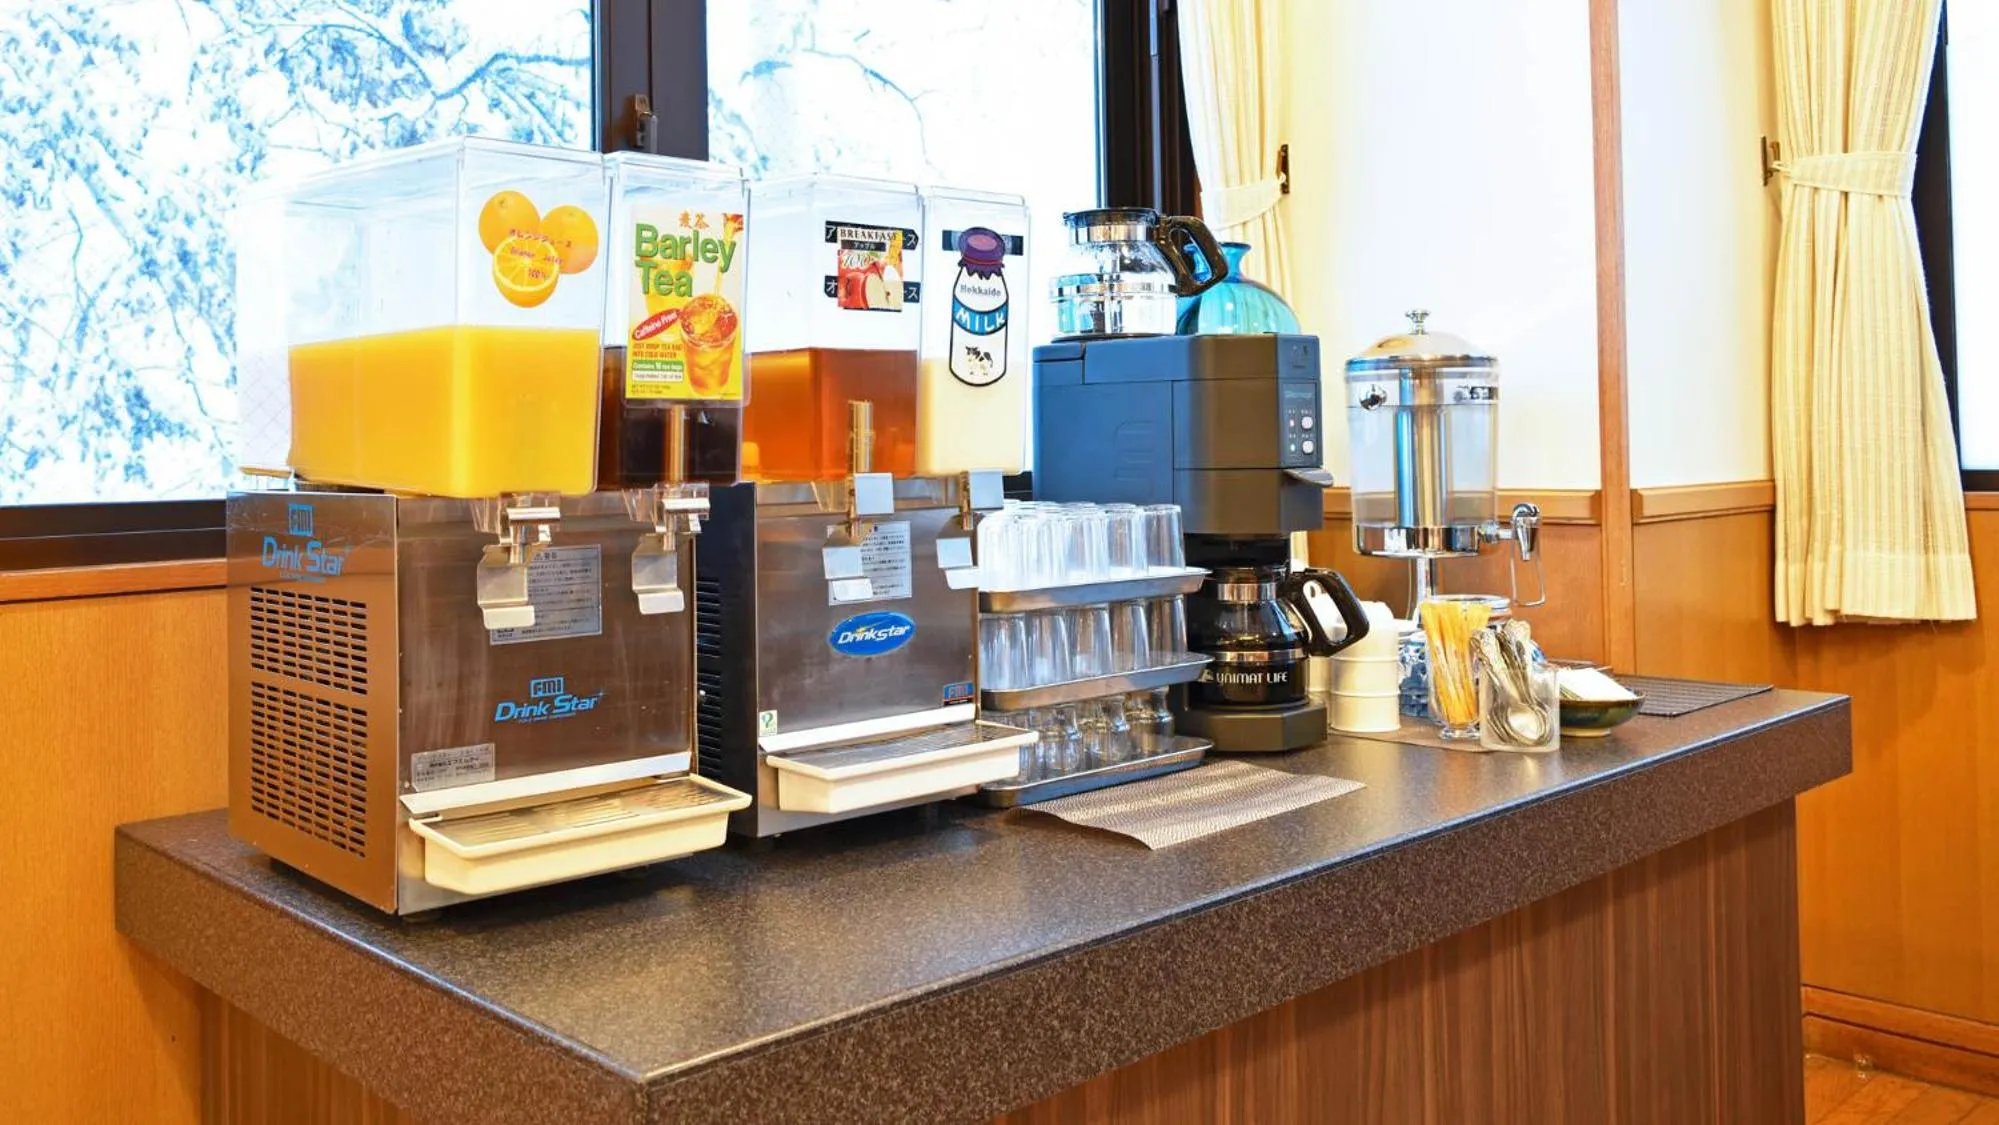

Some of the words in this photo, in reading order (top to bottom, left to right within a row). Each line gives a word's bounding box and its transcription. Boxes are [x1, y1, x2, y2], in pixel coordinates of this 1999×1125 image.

[680, 211, 709, 229] 麦茶
[636, 223, 736, 273] Barley
[635, 259, 693, 298] Tea
[960, 284, 1001, 297] Hokkaido
[956, 305, 1006, 331] MILK
[262, 535, 303, 571] Drink
[306, 540, 344, 577] Star
[1216, 671, 1263, 684] UNIMAT
[1266, 671, 1288, 684] LIFE
[495, 702, 551, 722] Drink
[552, 694, 598, 714] Star
